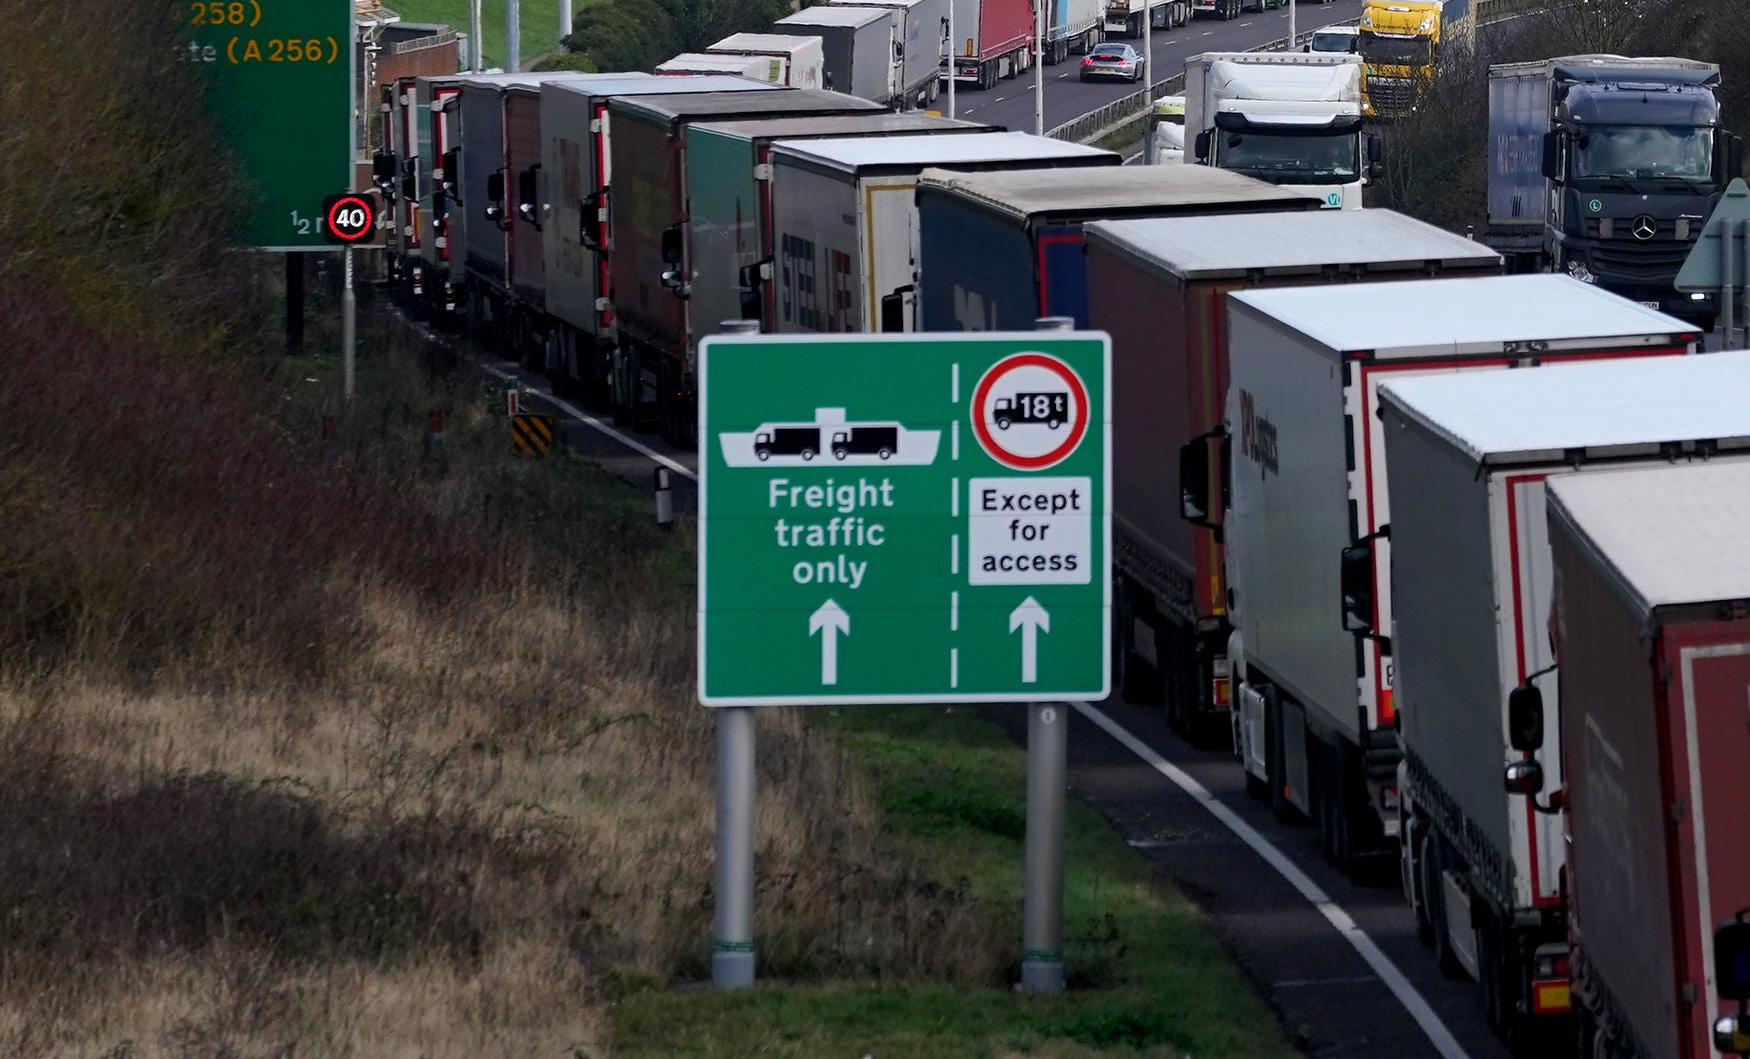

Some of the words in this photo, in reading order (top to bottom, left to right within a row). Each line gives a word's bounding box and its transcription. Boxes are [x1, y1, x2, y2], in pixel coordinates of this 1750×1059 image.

[227, 36, 338, 65] (A256)
[336, 208, 365, 228] 40
[768, 478, 894, 513] Freight
[982, 488, 1081, 515] Except
[775, 517, 885, 547] traffic
[1008, 519, 1050, 542] for
[792, 554, 867, 589] only
[982, 550, 1079, 572] access
